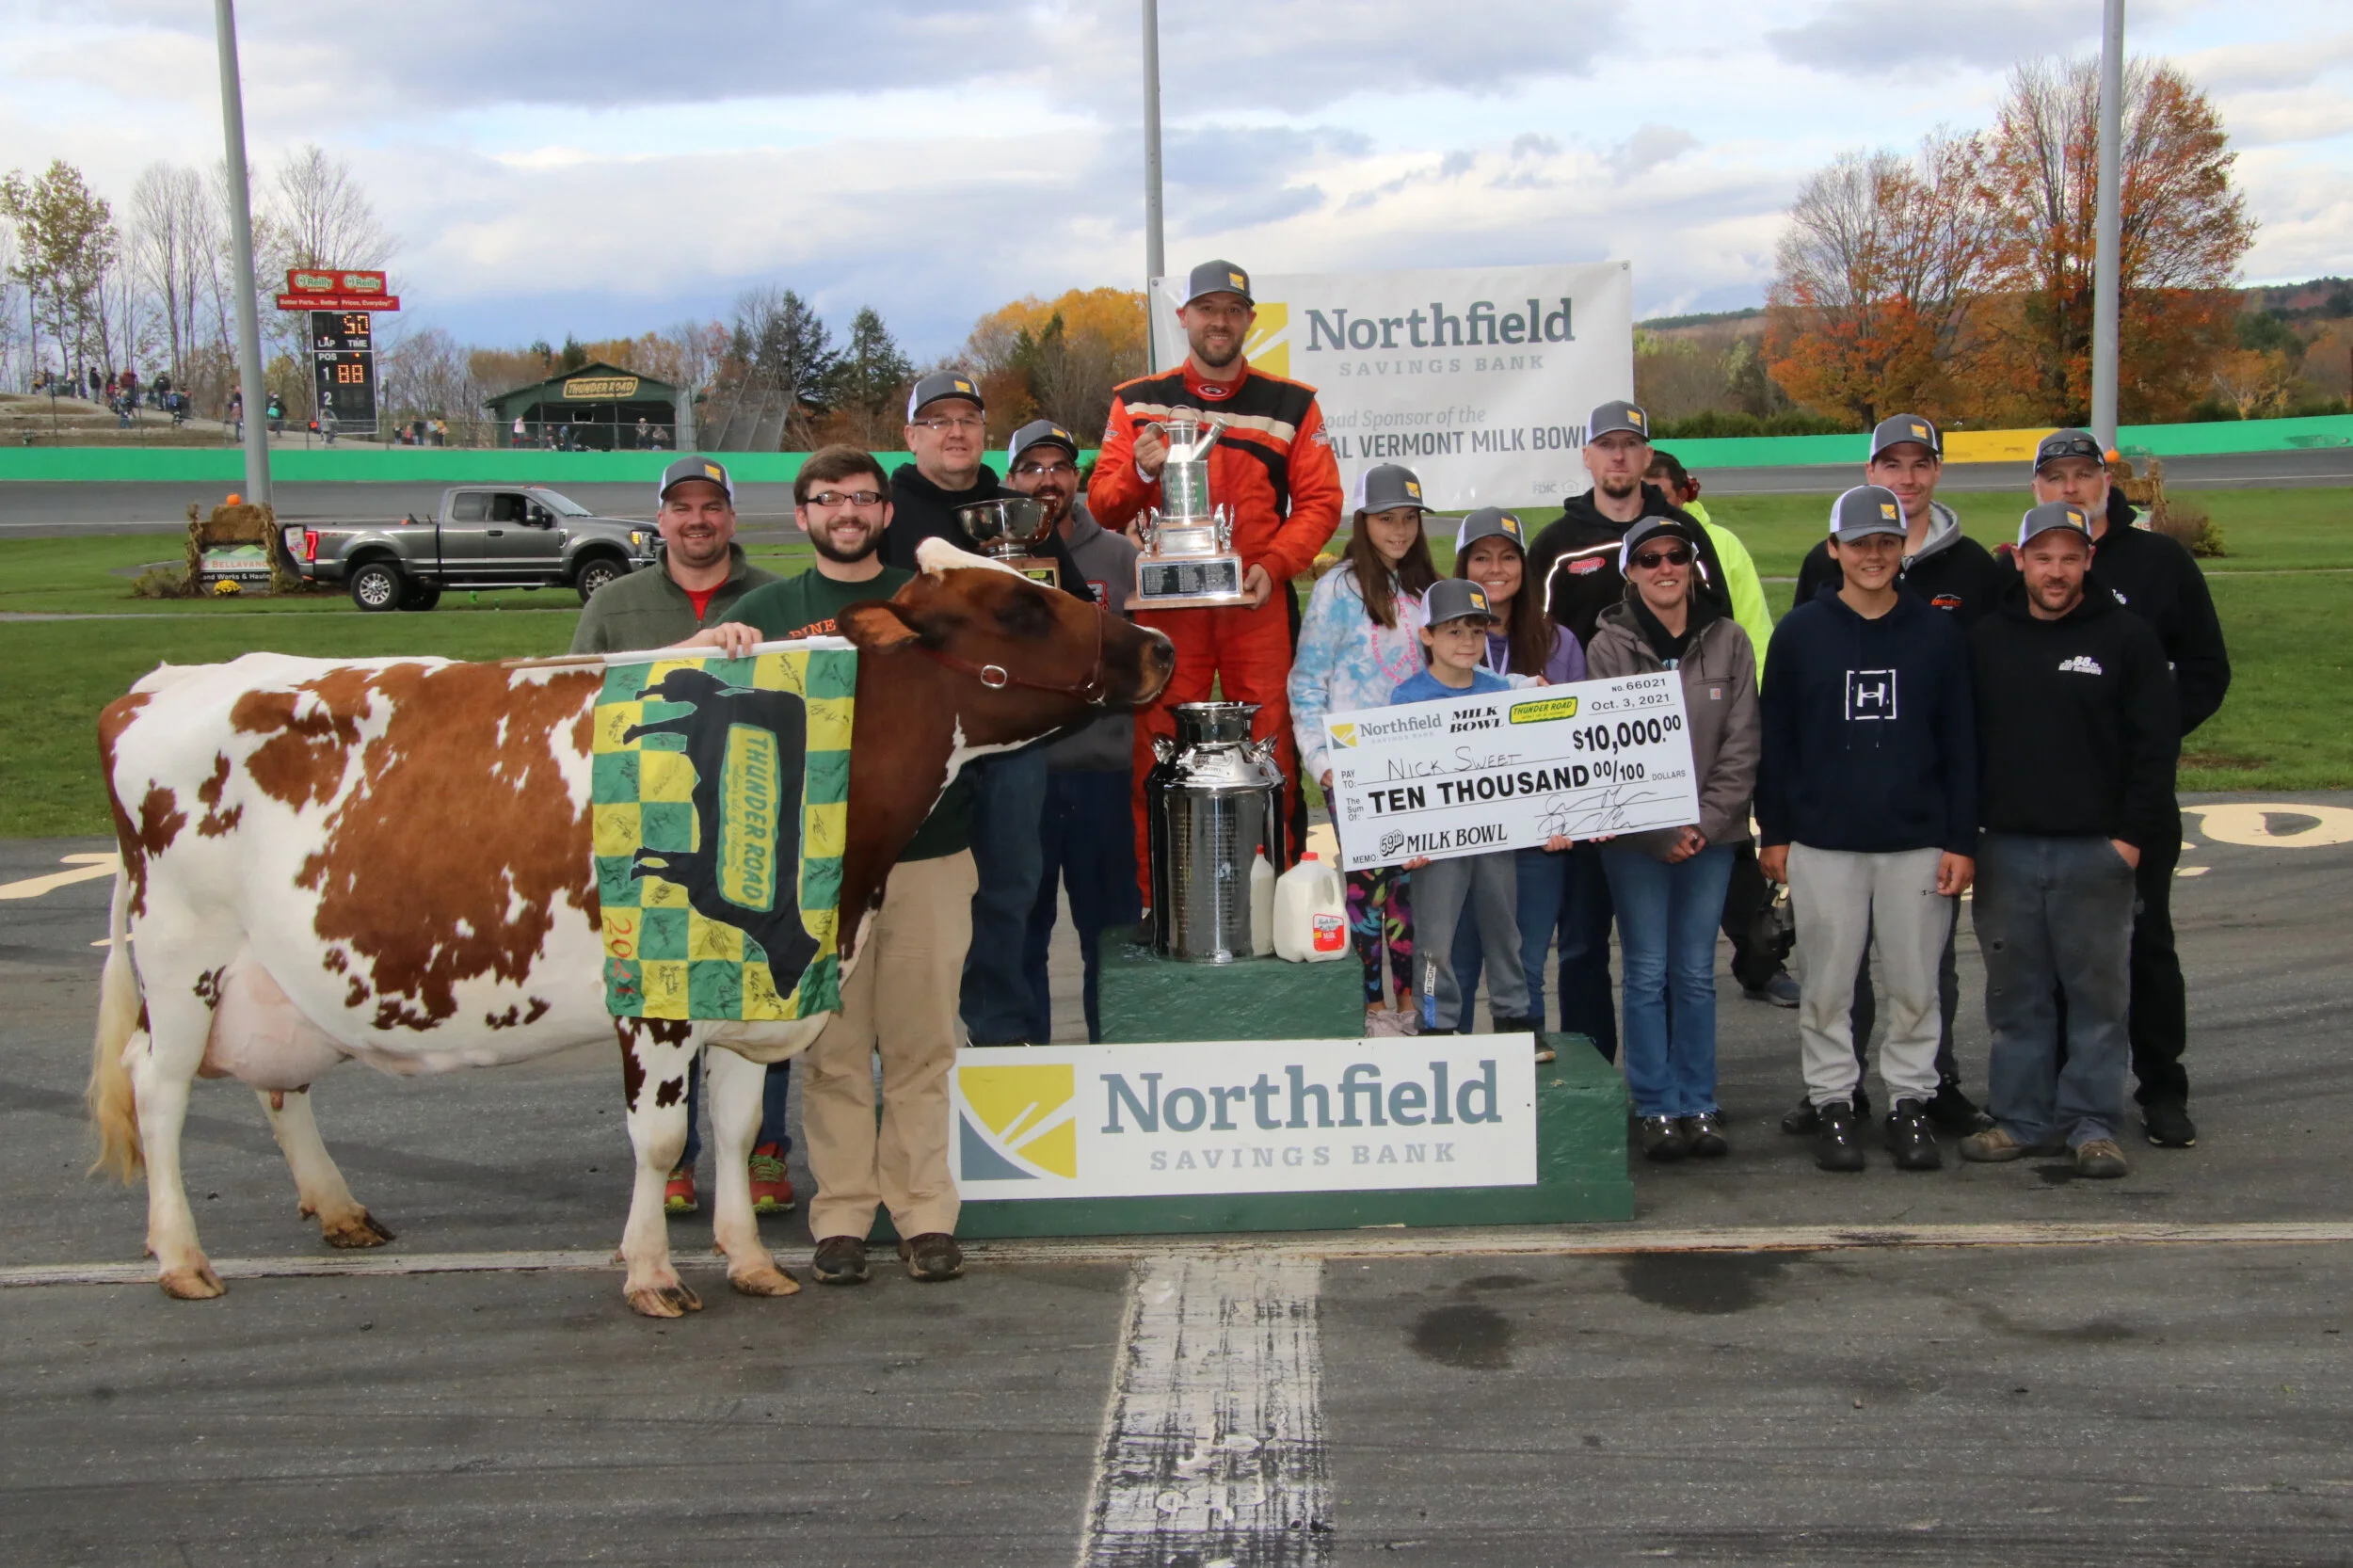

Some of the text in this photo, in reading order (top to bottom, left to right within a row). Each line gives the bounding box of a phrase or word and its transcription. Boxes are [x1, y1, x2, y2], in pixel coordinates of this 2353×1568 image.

[296, 275, 333, 288] O'Reilly
[1305, 297, 1576, 351] Northfield
[323, 367, 329, 380] 1
[338, 365, 363, 383] 88
[1339, 354, 1545, 376] SAVINGS BANK
[568, 381, 633, 394] THUNDER ROAD
[324, 392, 332, 405] 2
[1324, 405, 1486, 431] oud Sponsor of the
[1359, 431, 1465, 457] VERMONT
[1472, 428, 1525, 453] MILK
[1626, 679, 1666, 690] 66021
[1513, 701, 1572, 715] THUNDER ROAD
[1592, 694, 1670, 711] Oct. 3, 2021
[1452, 706, 1498, 720] MILK
[1359, 713, 1442, 737] Northfield
[1449, 718, 1504, 733] BOWL
[1341, 770, 1355, 779] PAY
[1387, 758, 1445, 781] NICK
[1368, 786, 1426, 814] TEN
[1436, 764, 1590, 805] THOUSAND
[1593, 760, 1644, 783] 00/100
[1652, 770, 1687, 781] DOLLARS
[1347, 806, 1364, 814] Sum
[741, 738, 769, 901] THUNDER ROAD
[1380, 824, 1508, 857] 59th MILK BOWL
[1353, 855, 1379, 865] MEMO:
[1425, 965, 1435, 994] NDER
[1100, 1060, 1502, 1134] Northfield
[1150, 1143, 1456, 1171] SAVINGS BANK
